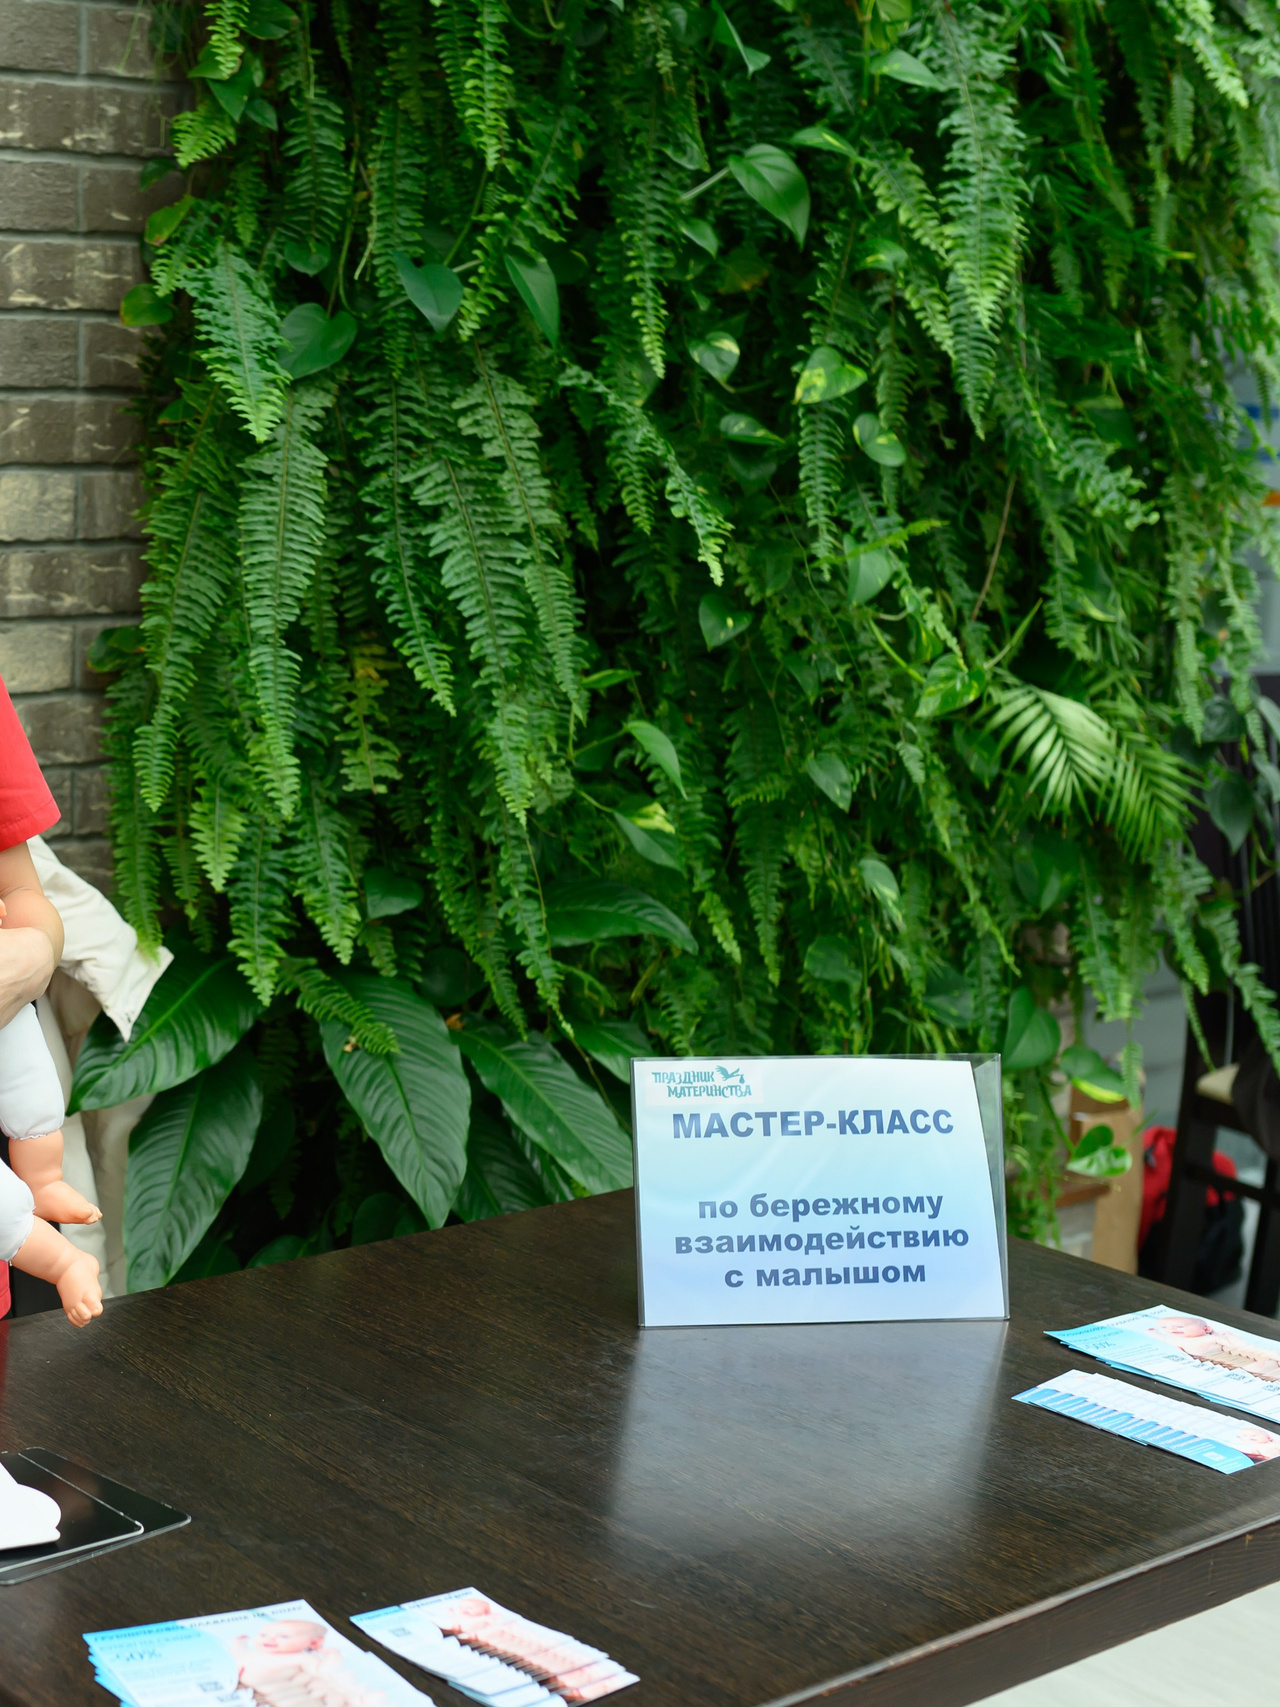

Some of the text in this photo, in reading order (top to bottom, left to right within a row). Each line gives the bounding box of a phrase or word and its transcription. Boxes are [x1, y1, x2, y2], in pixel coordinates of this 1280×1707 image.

[651, 1070, 715, 1085] ПРАЗДНИК
[666, 1084, 752, 1099] МАТЕРИНСТВА
[673, 1109, 954, 1139] МАСТЕР-КЛАСС
[698, 1193, 944, 1222] по бережному
[675, 1226, 969, 1255] взаимодействию
[724, 1264, 926, 1288] с малышом
